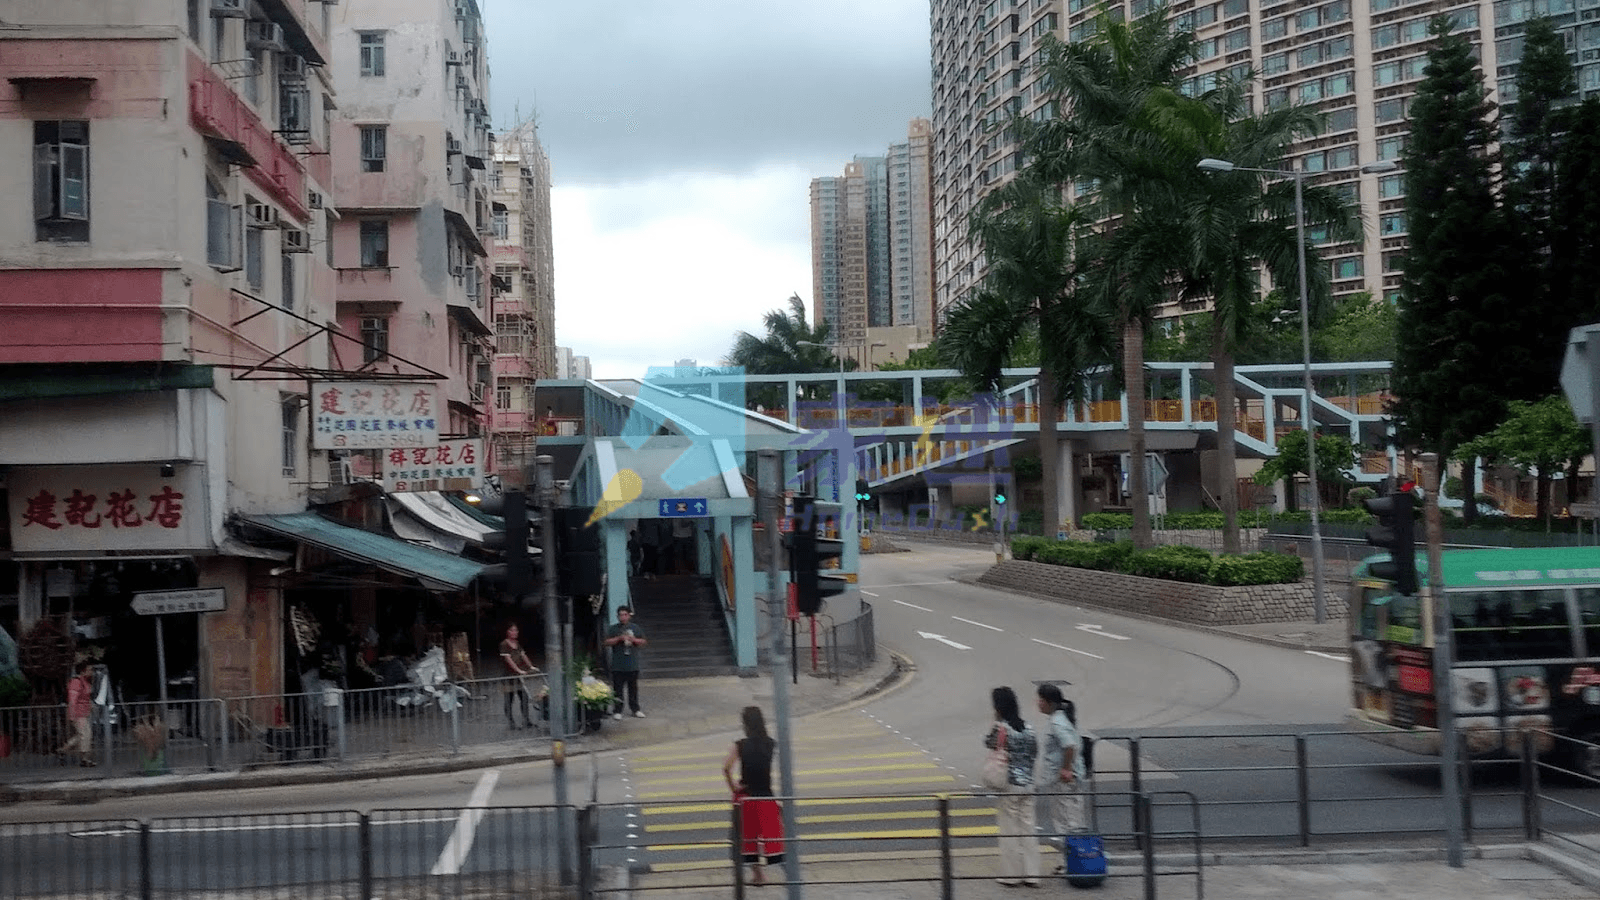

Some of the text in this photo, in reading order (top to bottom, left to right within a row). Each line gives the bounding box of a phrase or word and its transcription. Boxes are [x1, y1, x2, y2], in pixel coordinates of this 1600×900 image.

[319, 387, 432, 416] 建記花店
[22, 485, 184, 530] 建記花店
